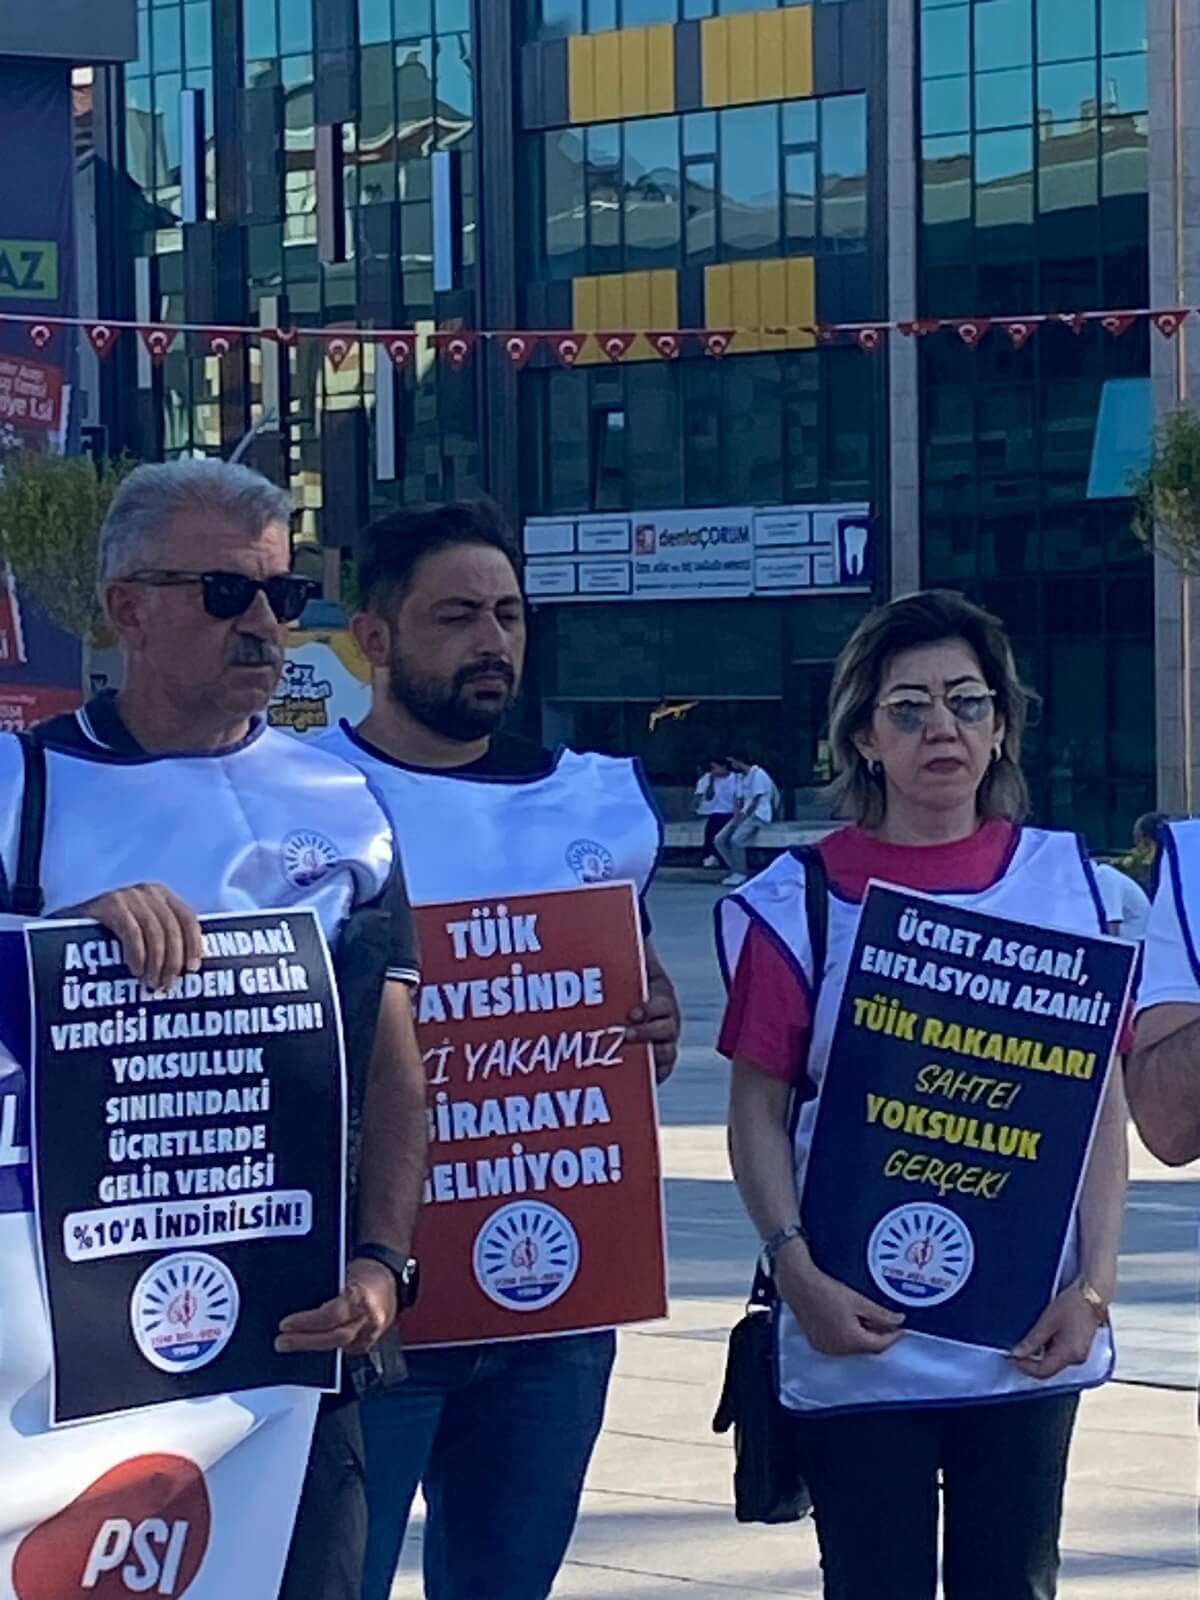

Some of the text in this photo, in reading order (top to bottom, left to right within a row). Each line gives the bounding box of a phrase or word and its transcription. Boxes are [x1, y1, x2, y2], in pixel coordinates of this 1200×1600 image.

[64, 939, 121, 975] AÇLI
[447, 904, 541, 960] TÜİK
[897, 908, 1090, 986] ÜCRET ASGARİ,
[239, 958, 309, 995] GELİR
[416, 963, 603, 1024] AYESİNDE
[860, 945, 1112, 1027] ENFLASYON AZAMİ!
[50, 1002, 323, 1051] VERGİSİ KALDIRILSIN!
[464, 1026, 626, 1081] YAKAMIZ
[853, 994, 1097, 1080] TÜİK RAKAMLARI
[111, 1048, 264, 1083] YOKSULLUK
[914, 1064, 1022, 1111] SAHTE!
[105, 1078, 270, 1124] SINIRINDAKİ
[865, 1092, 1042, 1161] YOKSULLUK
[108, 1124, 266, 1162] ÜCRETLERDE
[98, 1153, 275, 1202] GELİR VERGİSİ
[424, 1142, 622, 1200] ELMİYOR!
[883, 1149, 1012, 1199] GERÇEK!
[73, 1195, 304, 1250] %10'A İNDİRİLSİN!
[81, 1517, 189, 1595] PSI
